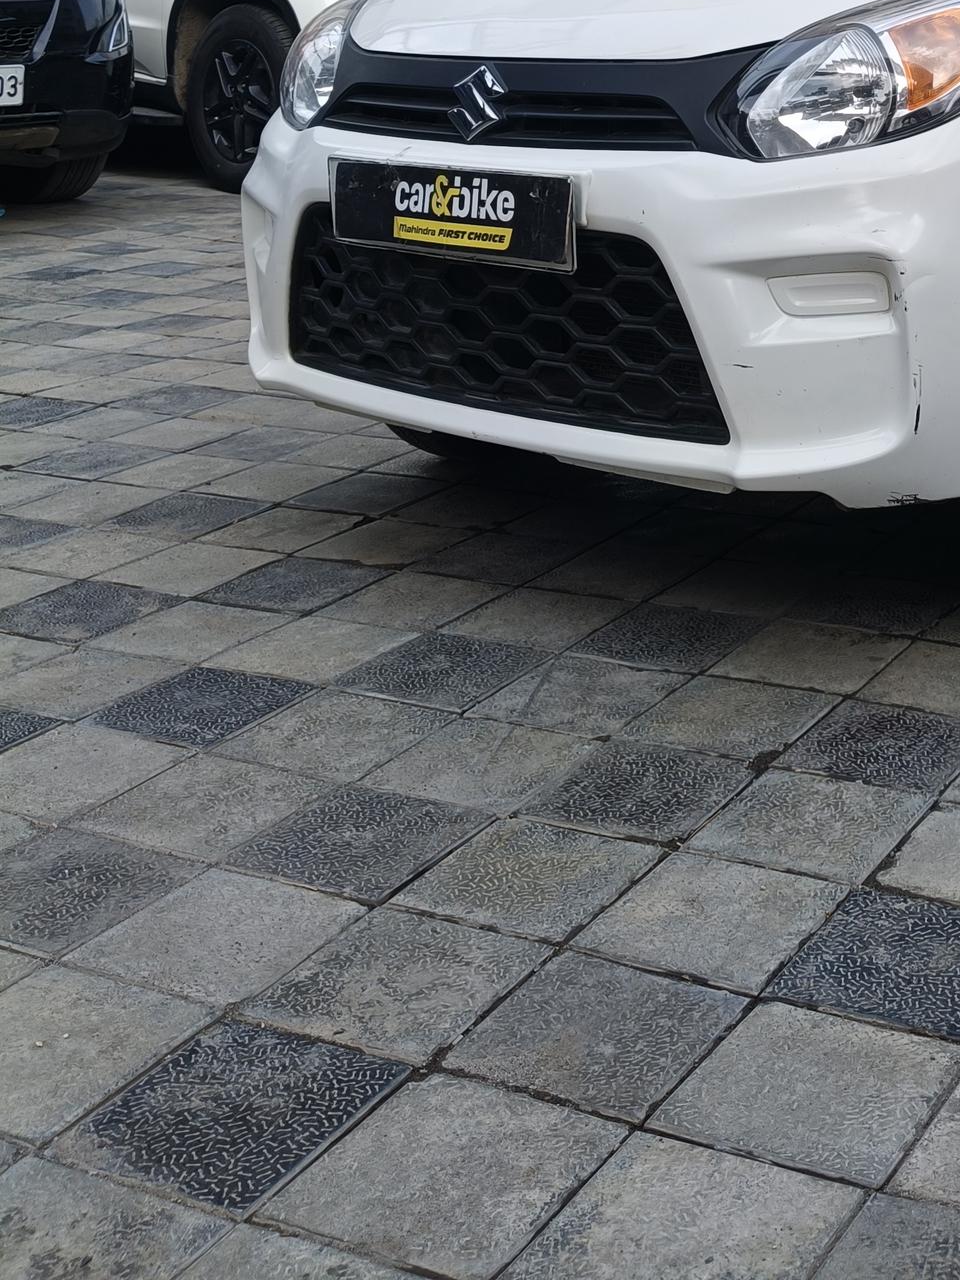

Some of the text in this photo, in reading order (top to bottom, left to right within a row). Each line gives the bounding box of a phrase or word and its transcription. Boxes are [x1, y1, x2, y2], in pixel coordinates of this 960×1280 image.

[394, 175, 515, 222] car&bike
[438, 228, 467, 240] FIRST
[467, 232, 507, 244] CHOICE
